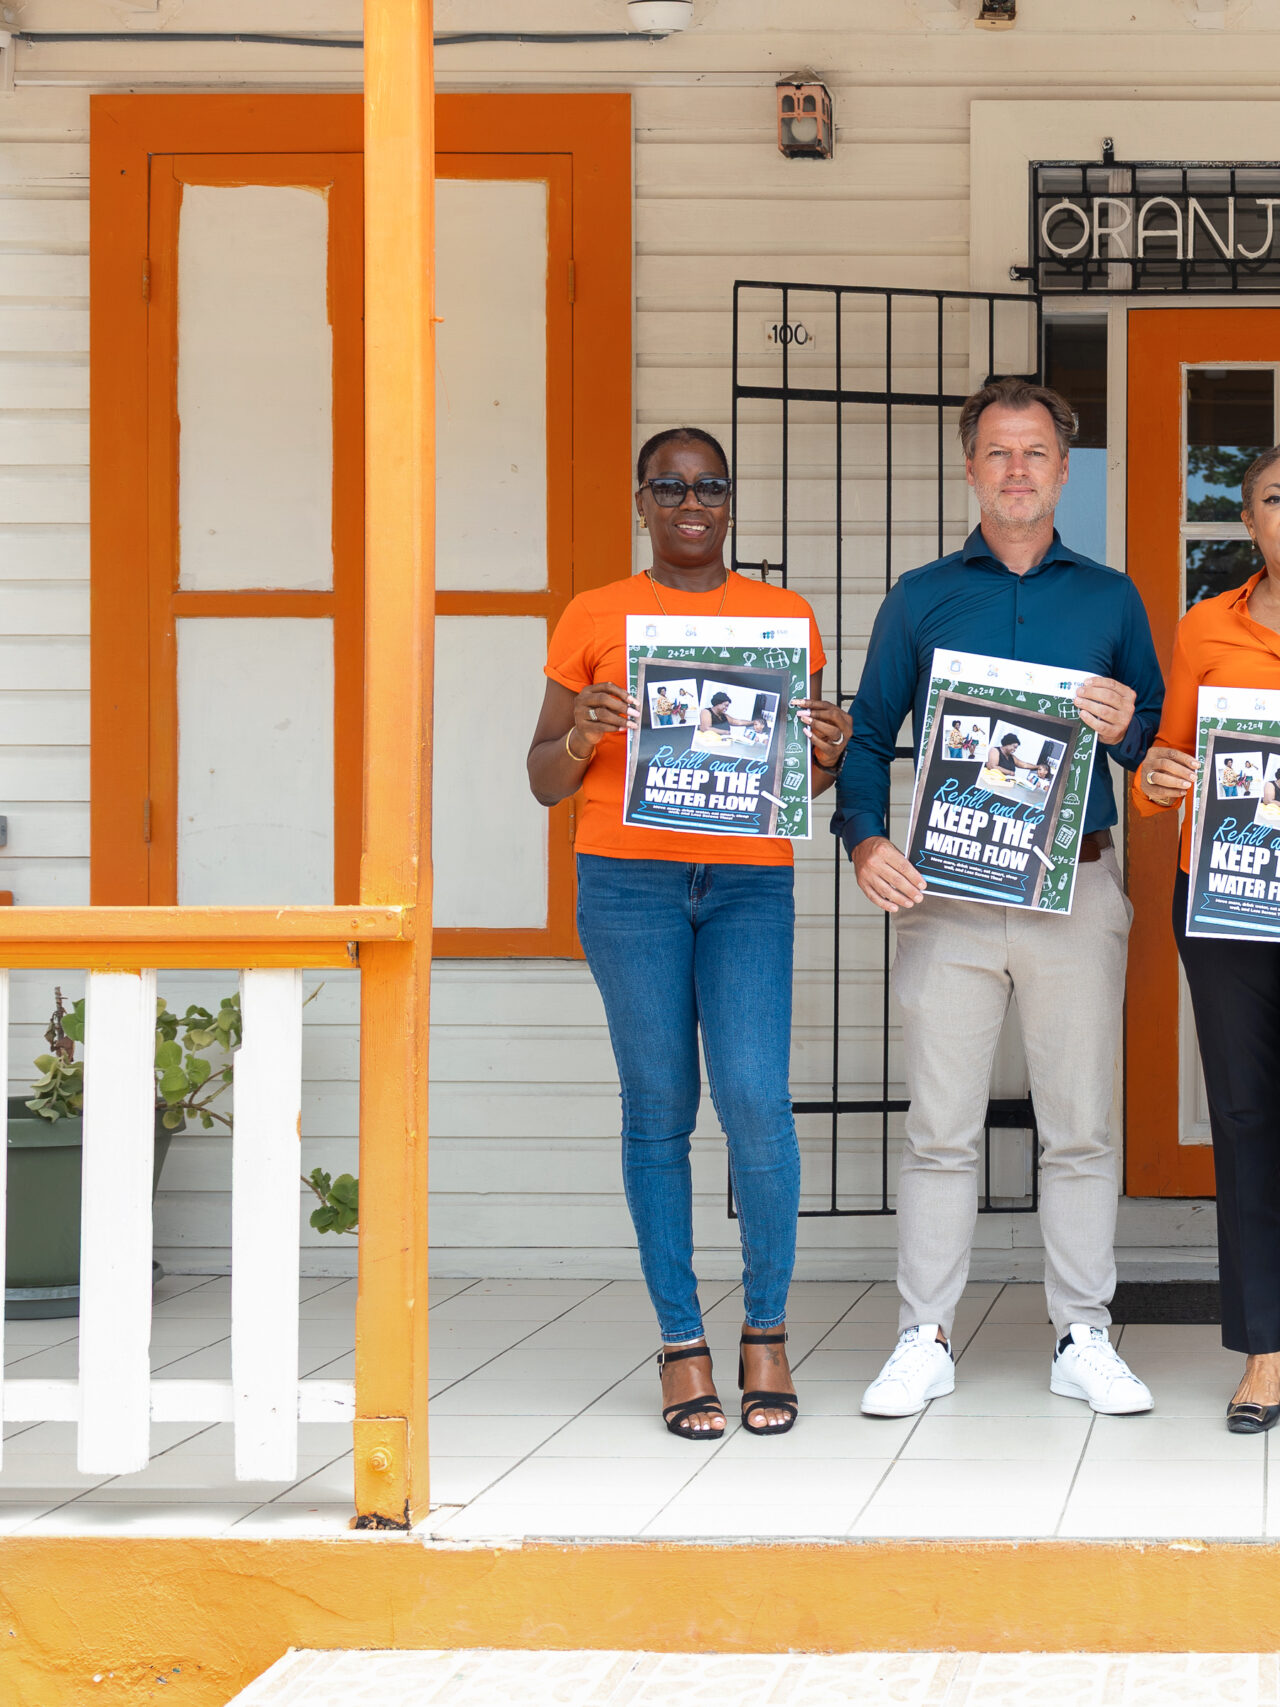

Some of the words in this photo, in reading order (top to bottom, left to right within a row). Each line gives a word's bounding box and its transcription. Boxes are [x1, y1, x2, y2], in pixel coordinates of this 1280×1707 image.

[772, 324, 808, 345] 100
[667, 648, 695, 658] 2+2=4
[967, 686, 994, 697] 2+2=4
[1236, 721, 1263, 731] 2+2=4
[648, 745, 711, 774] Refill
[709, 757, 743, 773] and
[745, 755, 769, 780] Go
[646, 766, 710, 791] KEEP
[713, 771, 761, 795] THE
[645, 788, 706, 808] WATER
[708, 794, 758, 812] FLOW
[933, 778, 994, 812] Refill
[989, 802, 1023, 819] and
[1022, 803, 1046, 830] Go
[928, 800, 990, 837] KEEP
[991, 814, 1037, 850] THE
[1212, 817, 1273, 851] Refill
[925, 830, 982, 861] WATER
[981, 844, 1030, 872] FLOW
[1210, 840, 1271, 875] KEEP
[1208, 872, 1266, 899] WATER
